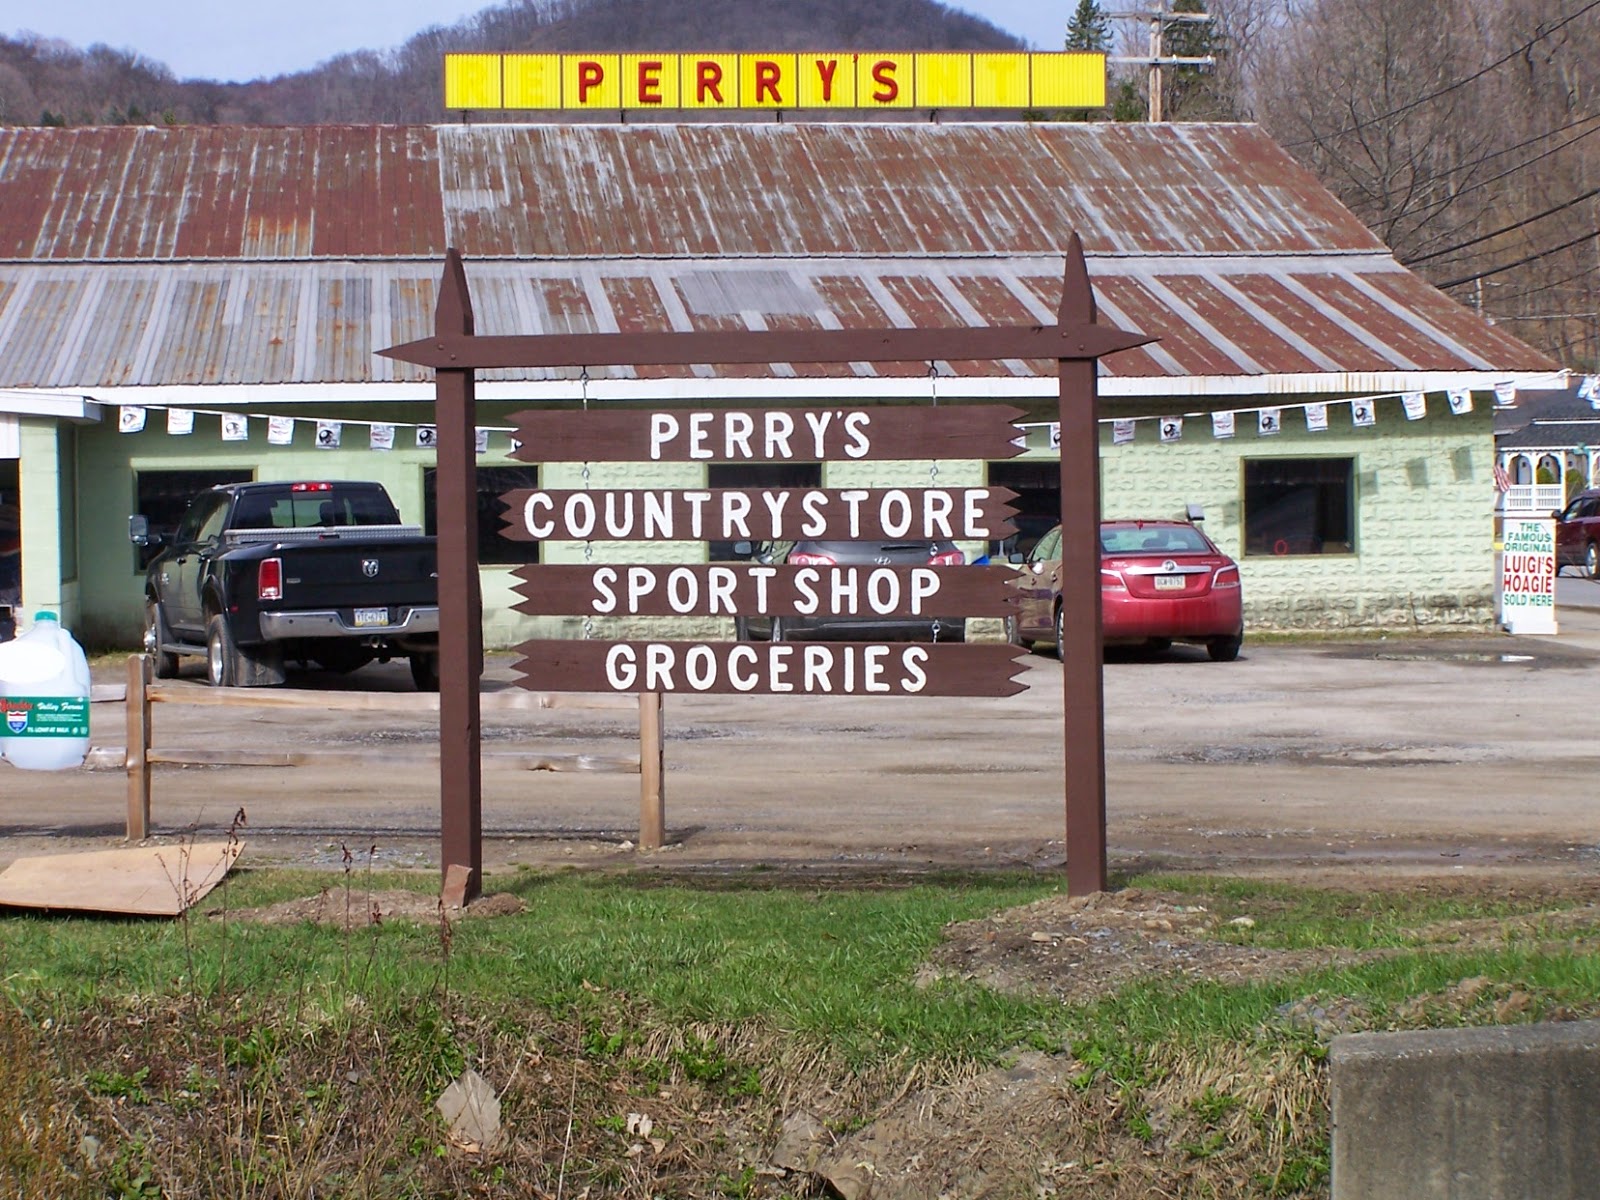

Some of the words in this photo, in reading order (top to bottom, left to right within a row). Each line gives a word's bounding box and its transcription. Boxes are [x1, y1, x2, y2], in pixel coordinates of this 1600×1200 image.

[578, 52, 899, 104] PERRY'S
[650, 411, 870, 459] PERRY'S
[1520, 523, 1540, 532] THE
[1508, 533, 1552, 542] FAMOUS
[1504, 543, 1553, 552] ORIGINAL
[1504, 555, 1554, 574] LUIGI'S
[592, 566, 777, 614] SPORT
[793, 567, 941, 615] SHOP
[1503, 575, 1552, 593] HOAGIE
[1504, 594, 1527, 605] SOLD
[1529, 595, 1553, 606] HERE
[605, 643, 929, 693] GROCERIES
